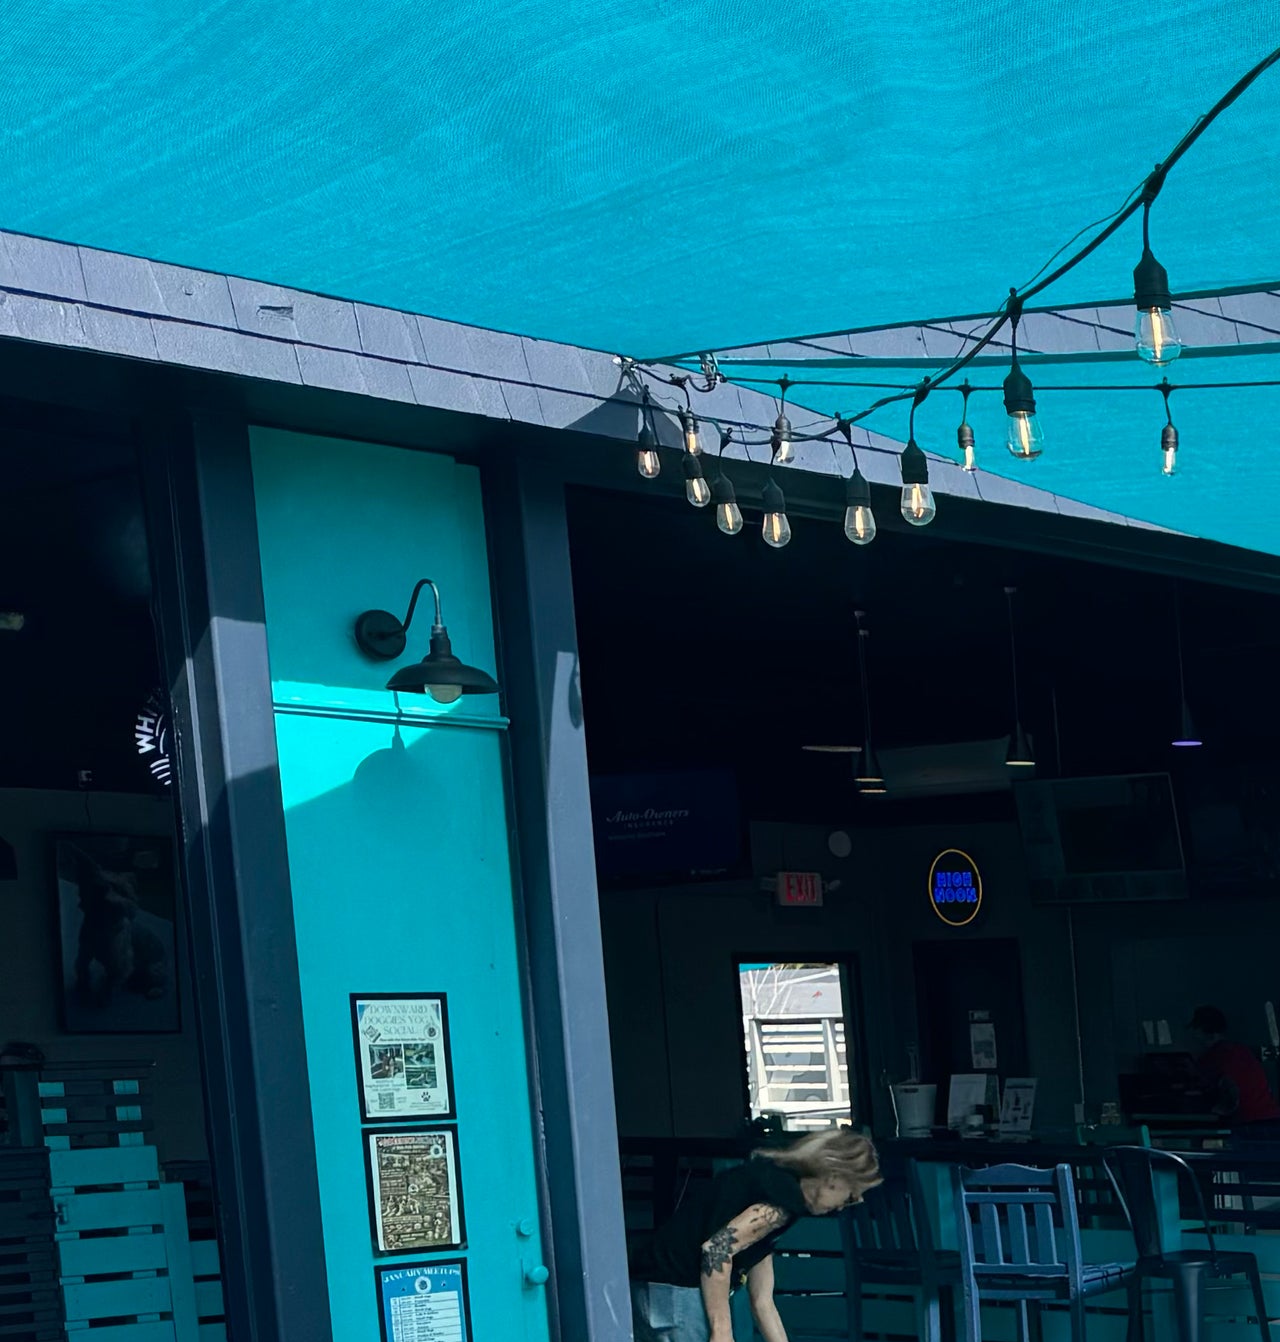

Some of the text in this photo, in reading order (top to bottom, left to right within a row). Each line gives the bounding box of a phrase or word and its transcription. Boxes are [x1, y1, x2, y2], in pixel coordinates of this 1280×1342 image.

[606, 808, 690, 823] Auto-Owners
[936, 871, 972, 888] HIGH
[784, 874, 817, 903] EXIT
[369, 1004, 428, 1014] DOWNWARD
[408, 1015, 435, 1025] YOGA
[383, 1025, 416, 1035] SOCIAL
